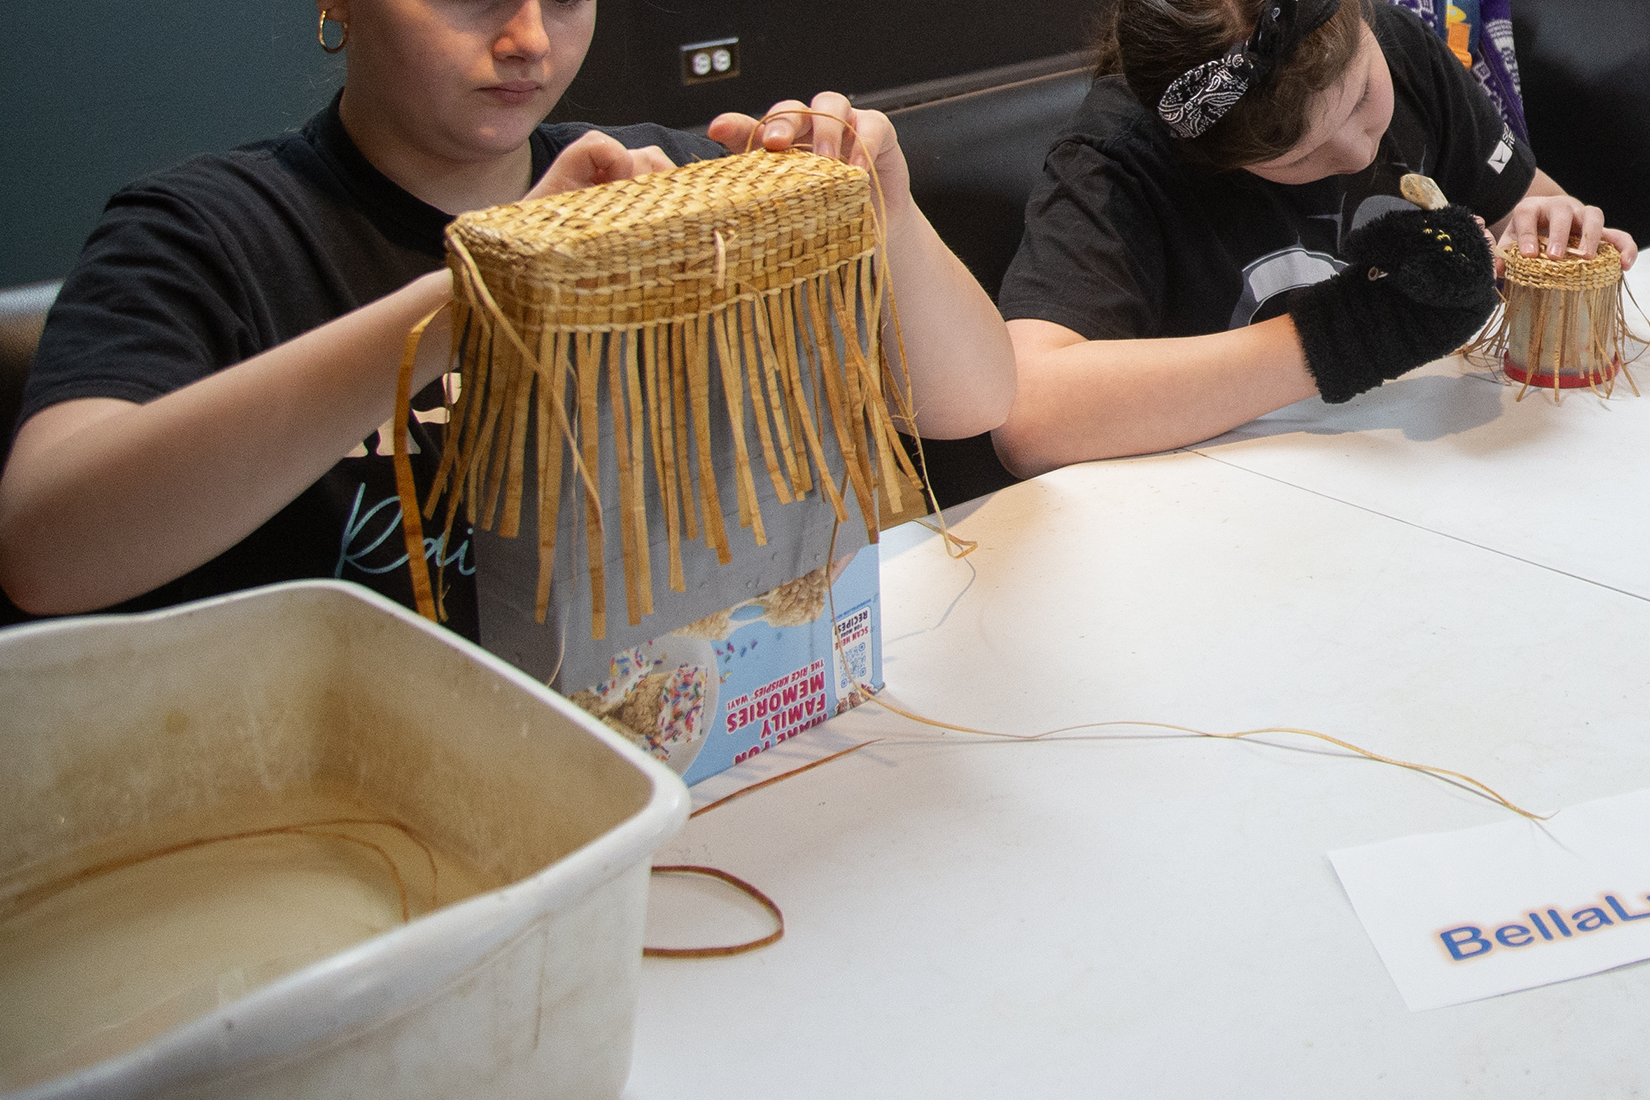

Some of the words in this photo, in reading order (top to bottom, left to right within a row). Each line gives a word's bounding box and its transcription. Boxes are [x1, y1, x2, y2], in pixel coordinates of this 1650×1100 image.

[851, 626, 869, 641] SCAN
[834, 636, 851, 651] HEE
[790, 666, 809, 683] RICE
[810, 659, 824, 673] THE
[726, 671, 825, 733] MEMORIES
[727, 694, 750, 711] WAY!
[760, 693, 826, 740] FAMILY
